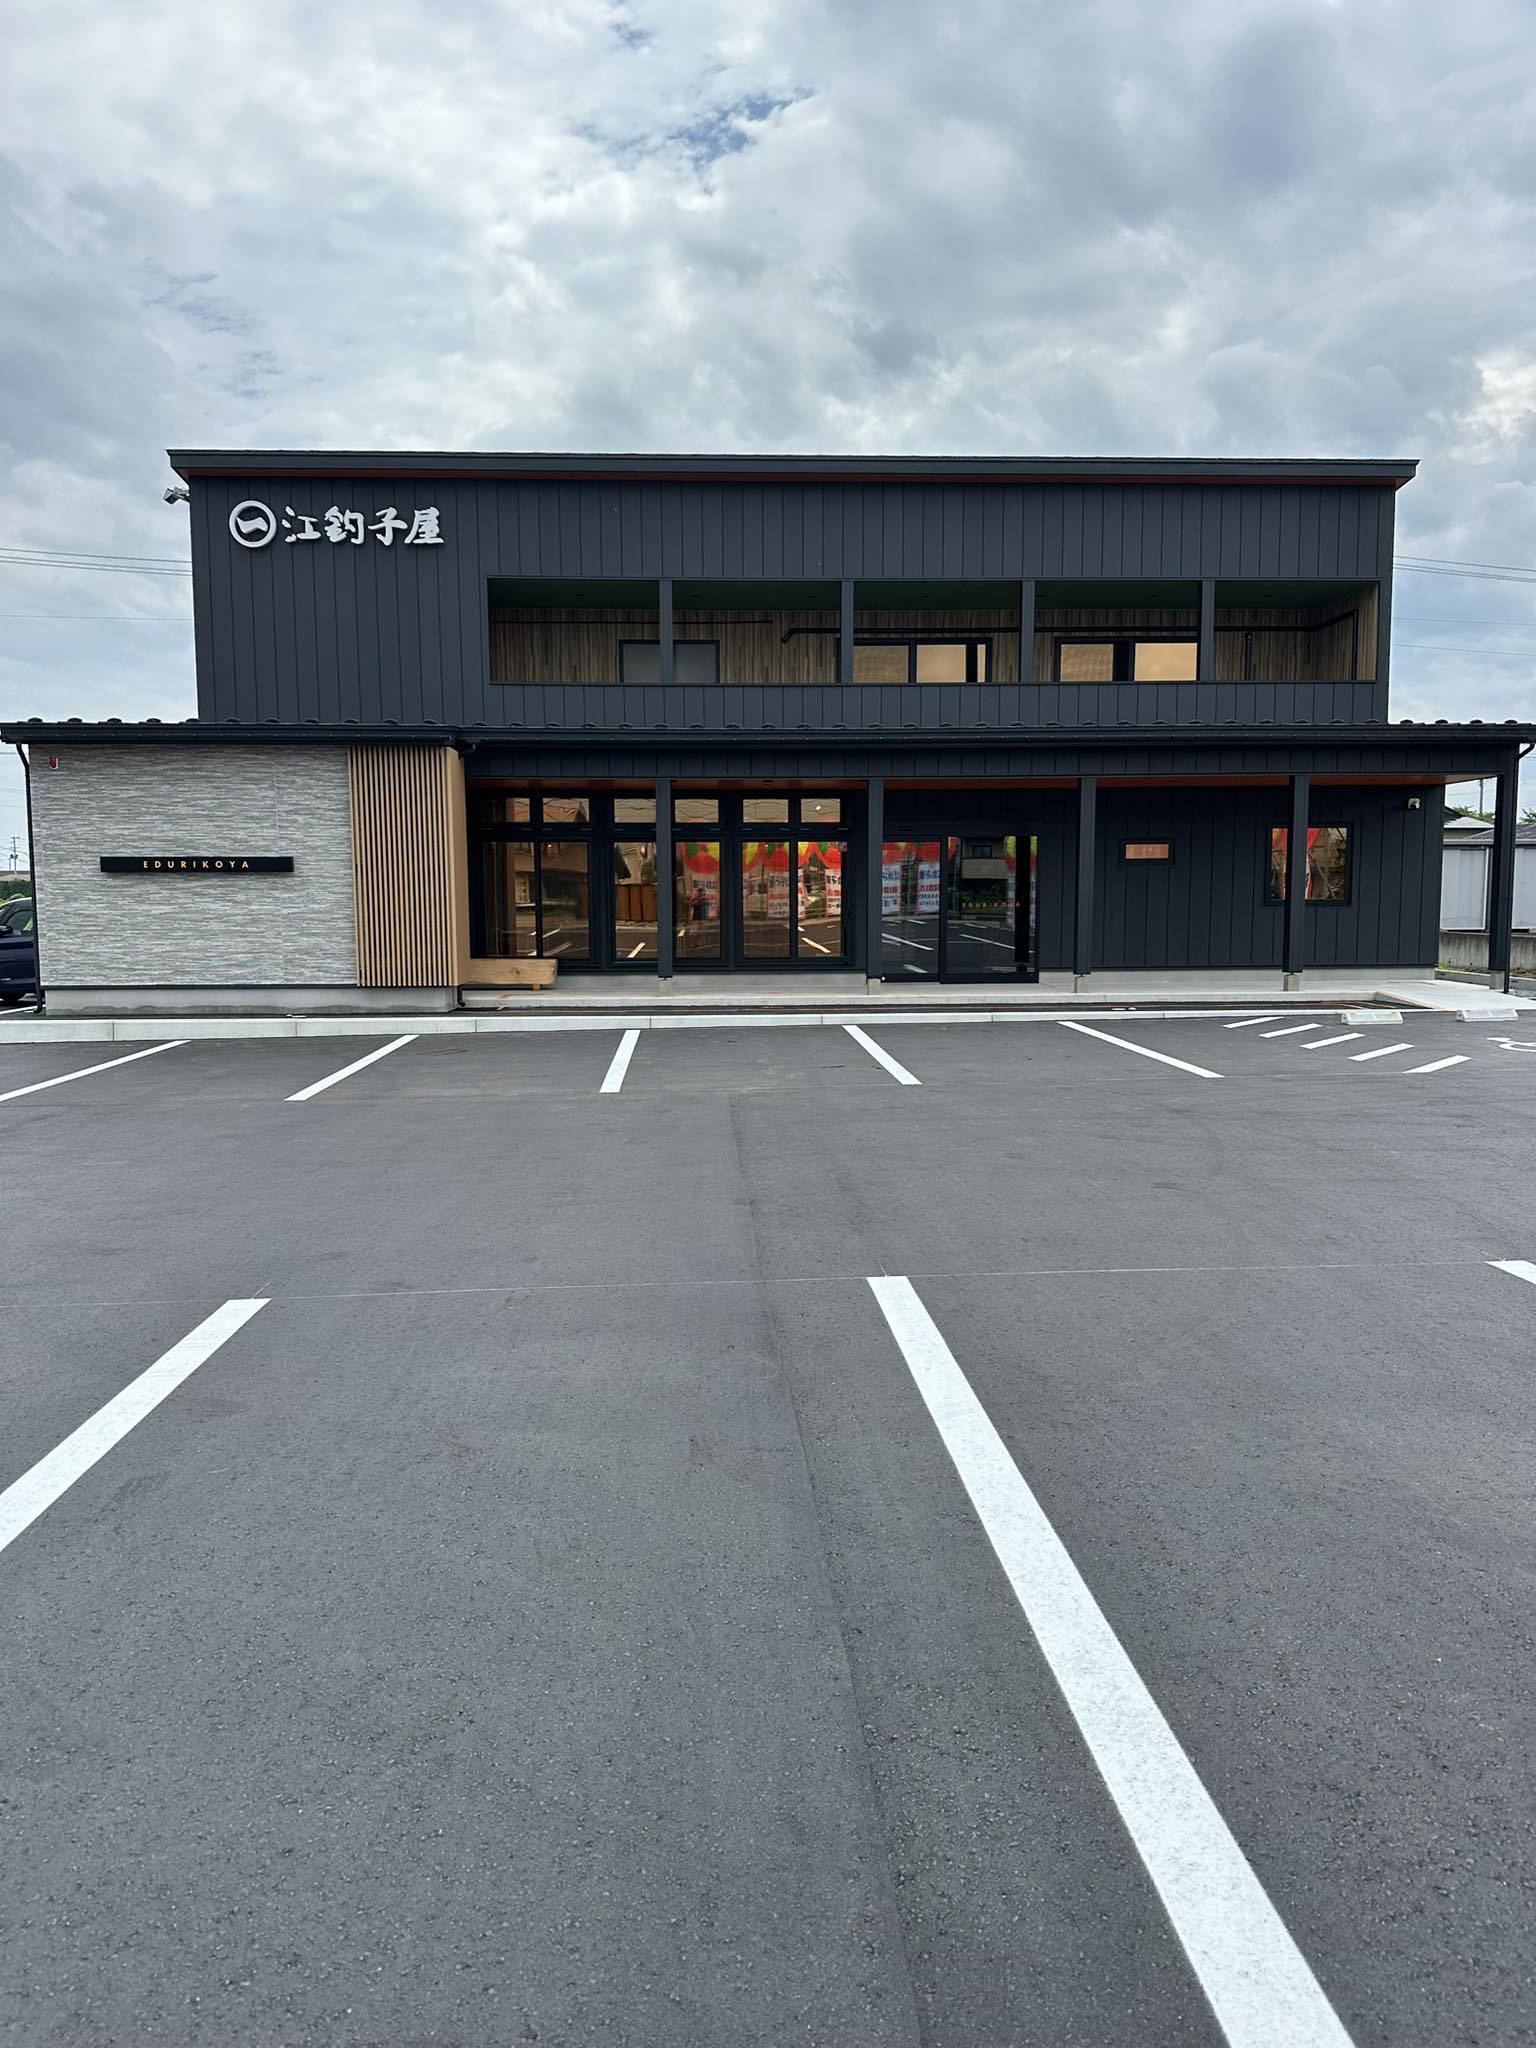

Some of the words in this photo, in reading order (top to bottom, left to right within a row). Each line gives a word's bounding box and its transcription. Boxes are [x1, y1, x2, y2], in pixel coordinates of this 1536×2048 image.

[282, 505, 445, 546] 江釣子屋
[143, 860, 250, 869] EDURIKOYA
